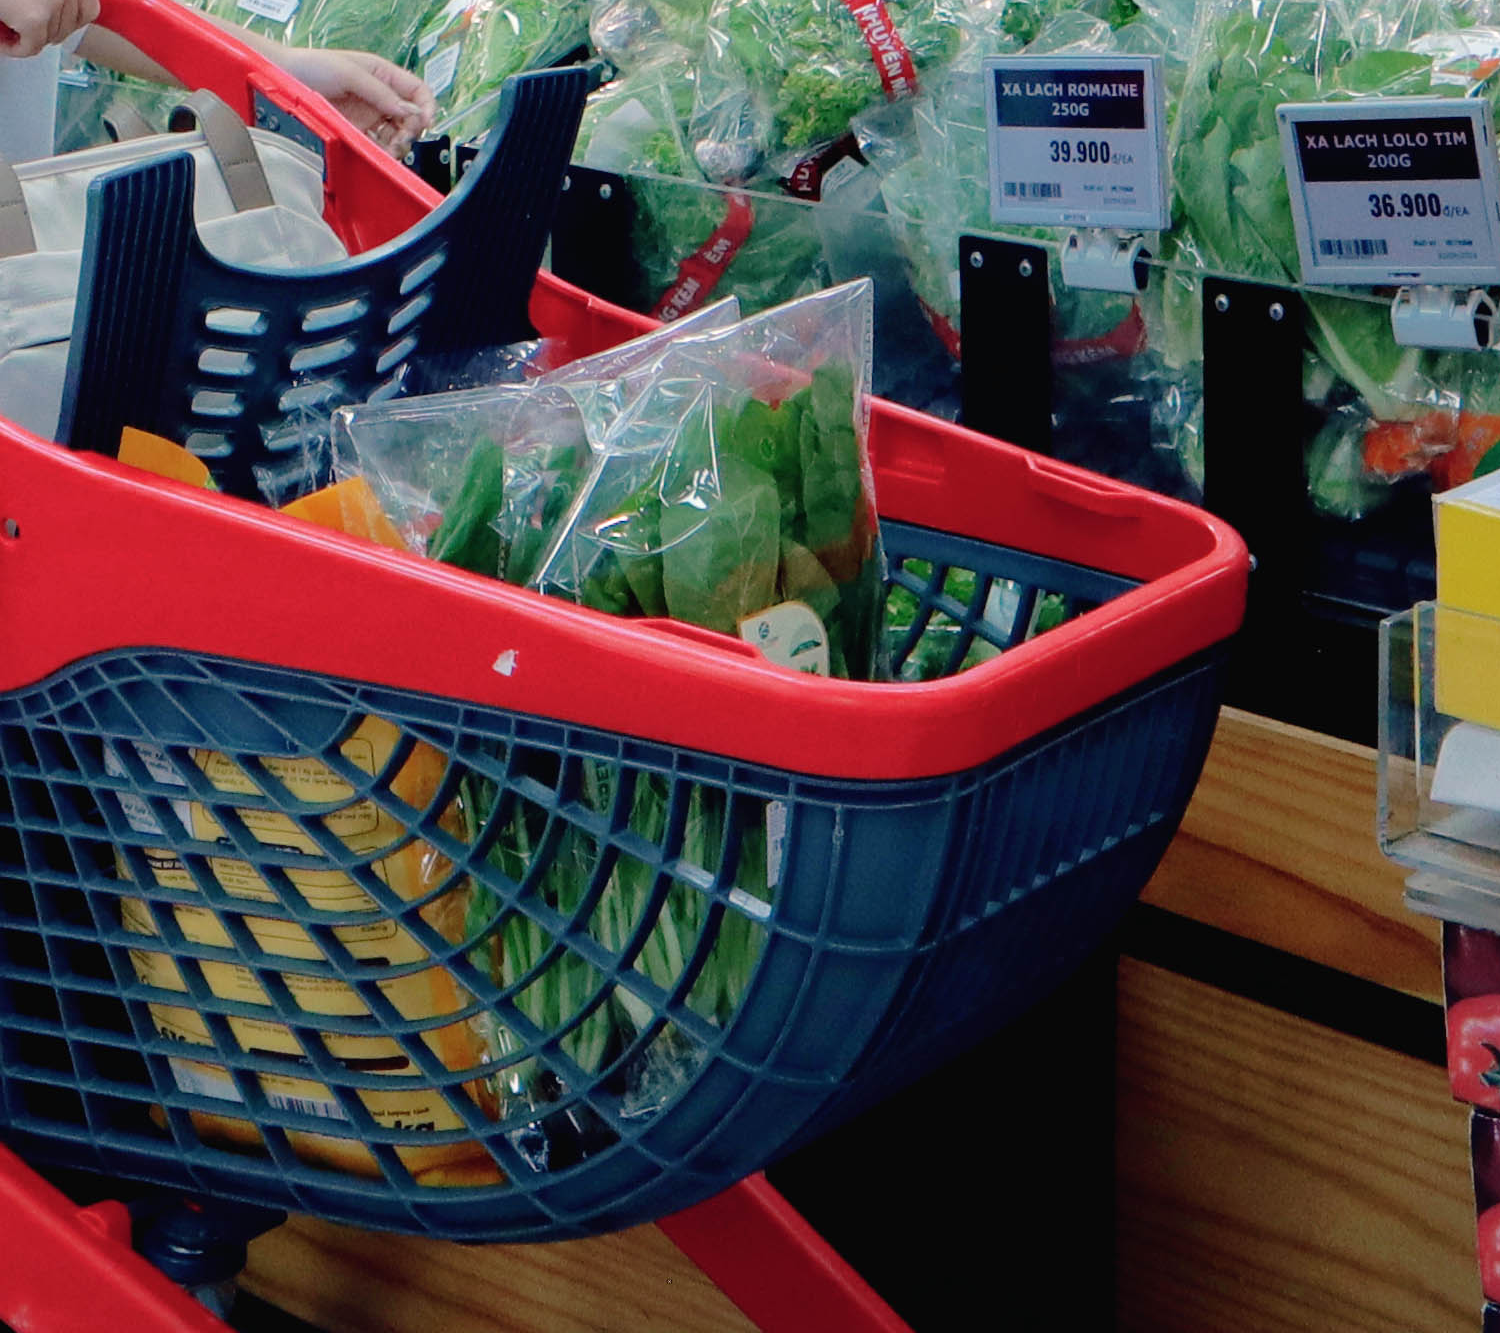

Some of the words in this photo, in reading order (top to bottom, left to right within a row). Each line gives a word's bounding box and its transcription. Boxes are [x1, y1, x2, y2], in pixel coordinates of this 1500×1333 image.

[1003, 83, 1022, 95] XA
[1026, 84, 1063, 96] LACH
[1068, 84, 1138, 96] ROMAINE
[1052, 103, 1089, 115] 250G
[1306, 135, 1329, 148] XA
[1334, 134, 1377, 148] LACH
[1384, 134, 1428, 147] LOLO
[1435, 132, 1467, 145] TIM
[1051, 141, 1110, 163] 39.900
[1368, 154, 1411, 168] 200G
[1369, 193, 1440, 217] 36.900
